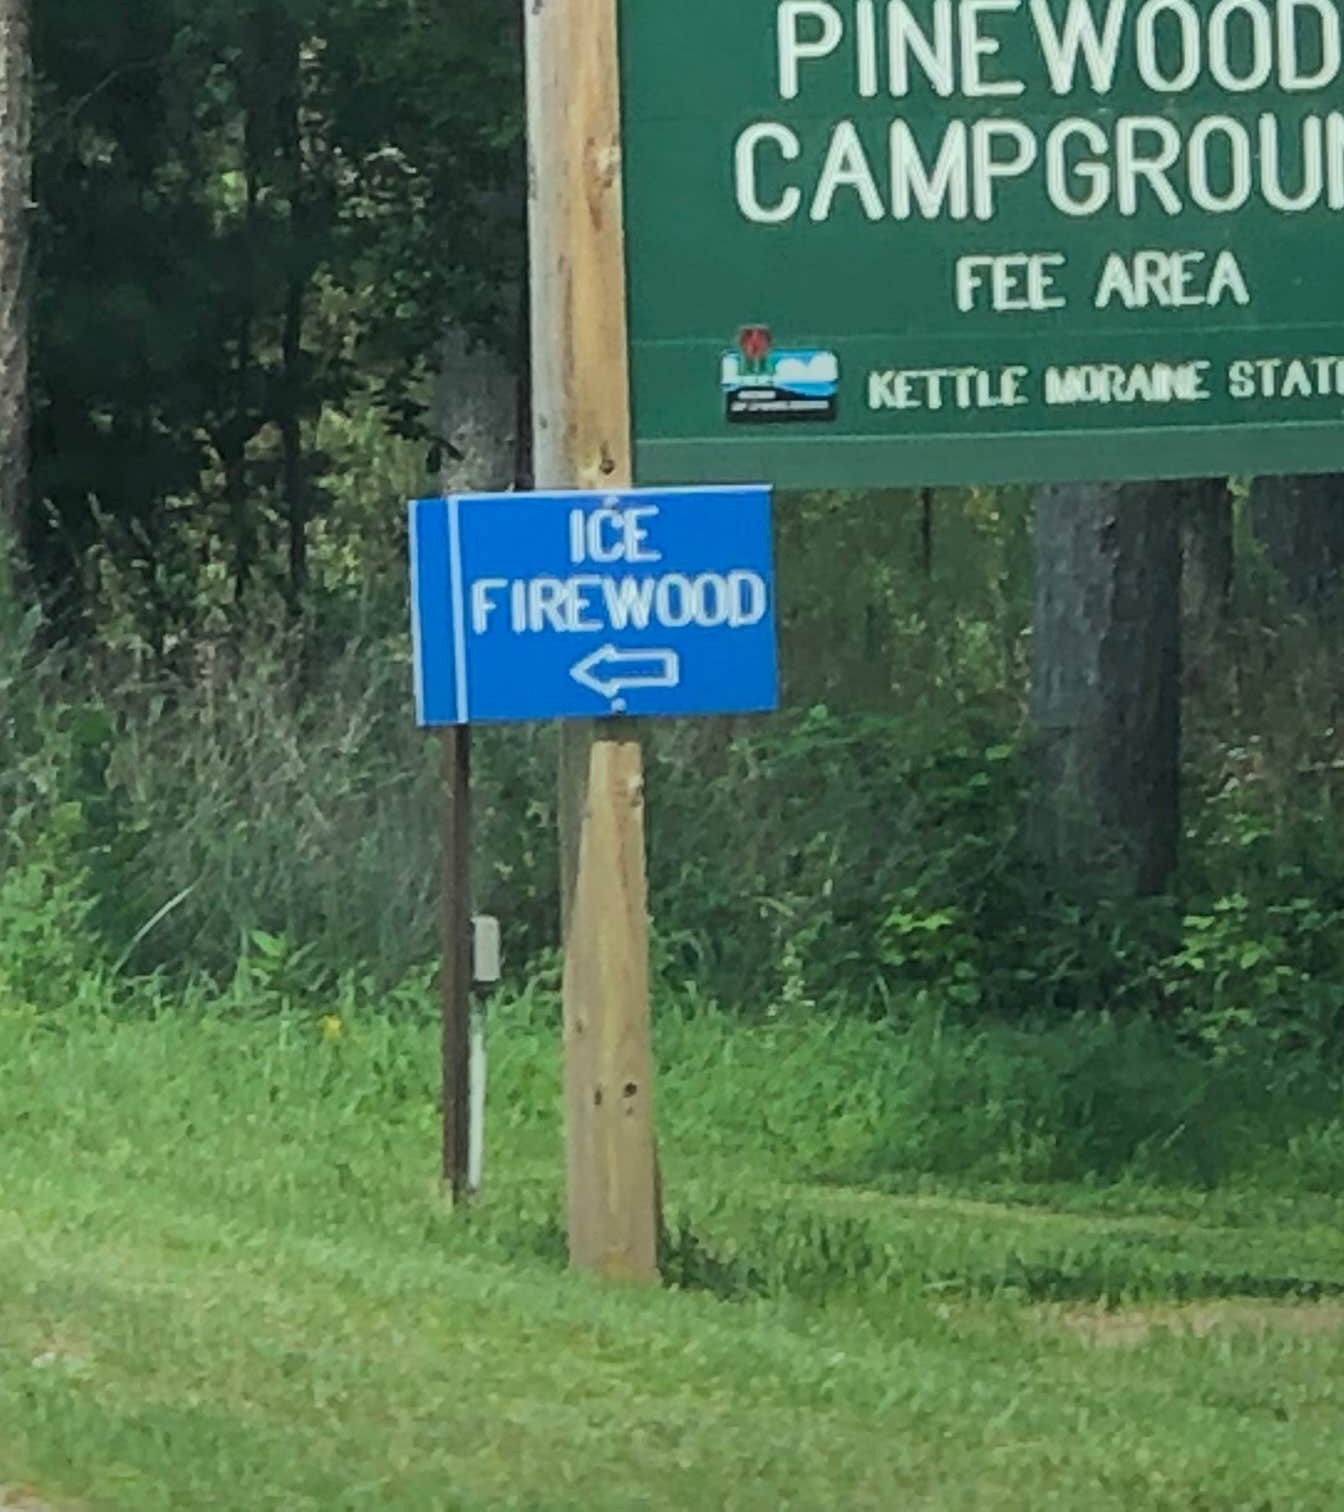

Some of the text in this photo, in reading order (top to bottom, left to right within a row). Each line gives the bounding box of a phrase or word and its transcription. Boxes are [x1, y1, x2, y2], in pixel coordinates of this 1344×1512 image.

[956, 249, 1250, 313] FEE AREA
[867, 364, 1028, 410] KETTLE
[1044, 359, 1210, 406] MORAINE
[570, 506, 662, 563] ICE
[471, 569, 767, 634] FIREWOOD
